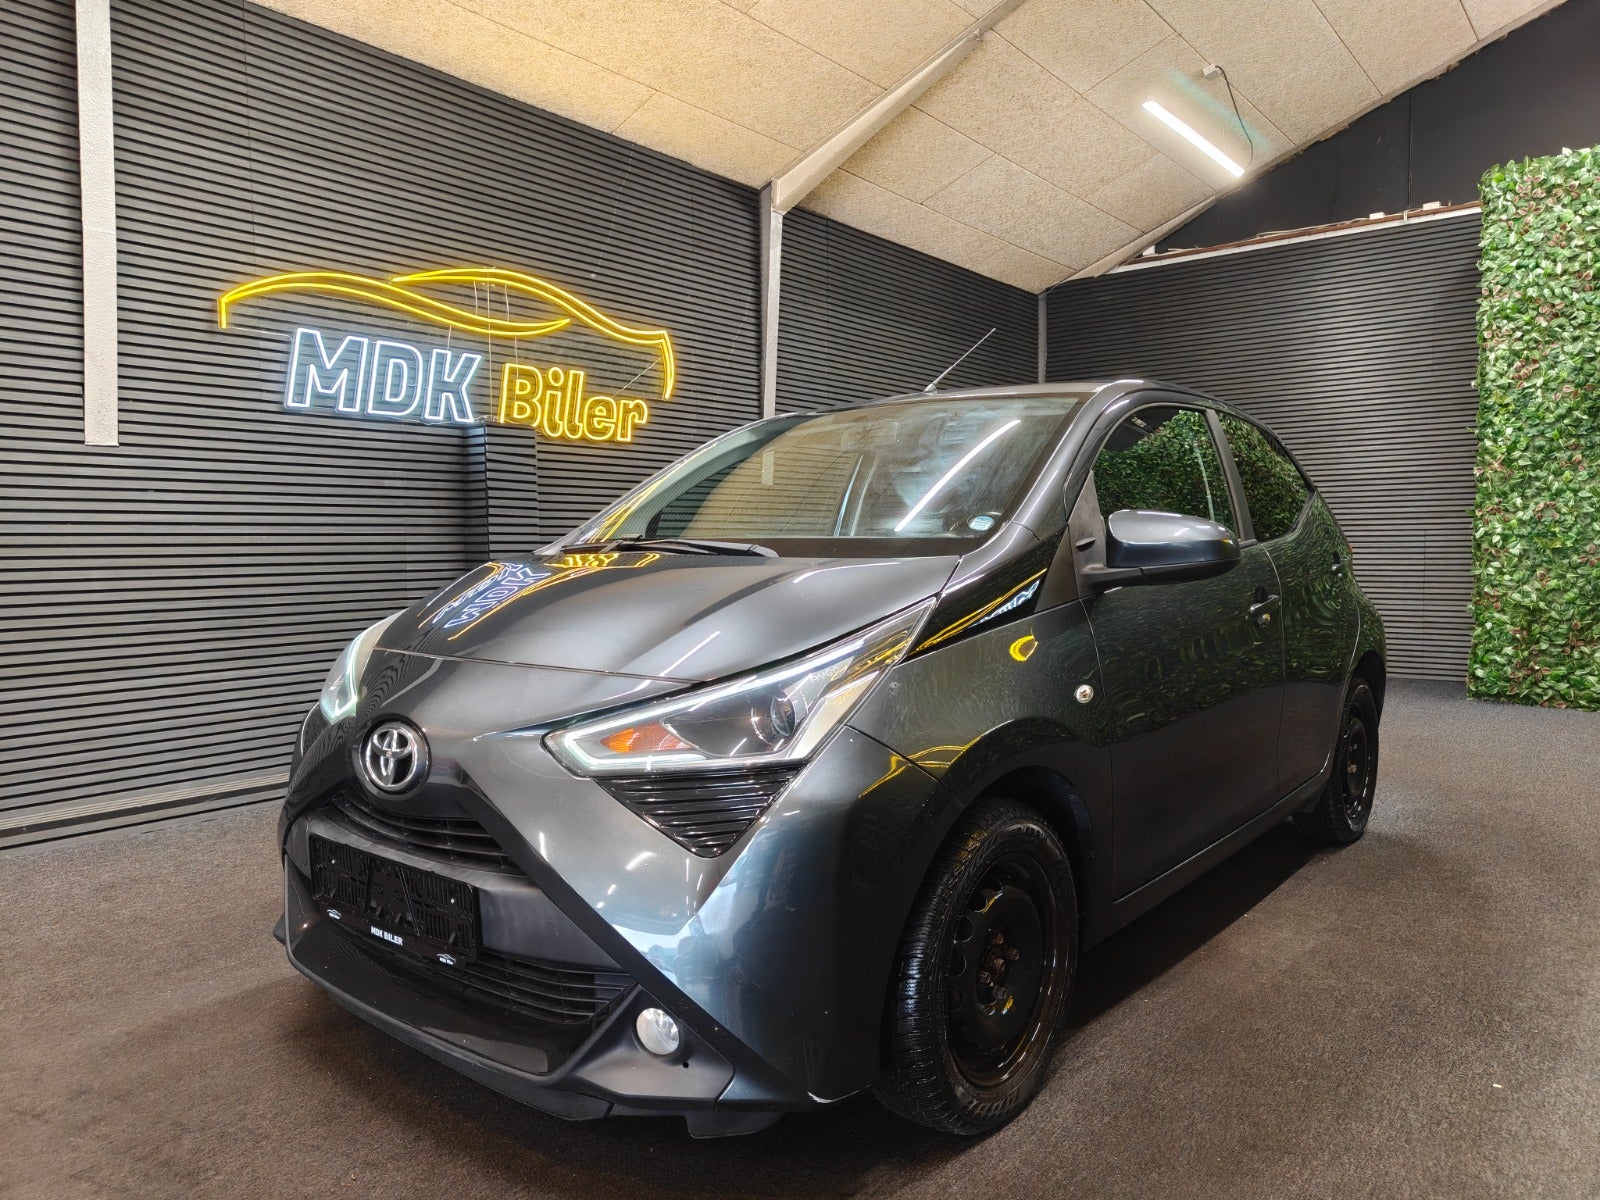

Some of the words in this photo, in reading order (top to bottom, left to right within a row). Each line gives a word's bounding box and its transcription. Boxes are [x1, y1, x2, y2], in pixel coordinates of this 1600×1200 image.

[285, 327, 482, 423] MDK
[498, 363, 648, 442] Biler
[370, 925, 384, 938] MDK
[383, 931, 403, 946] BILER
